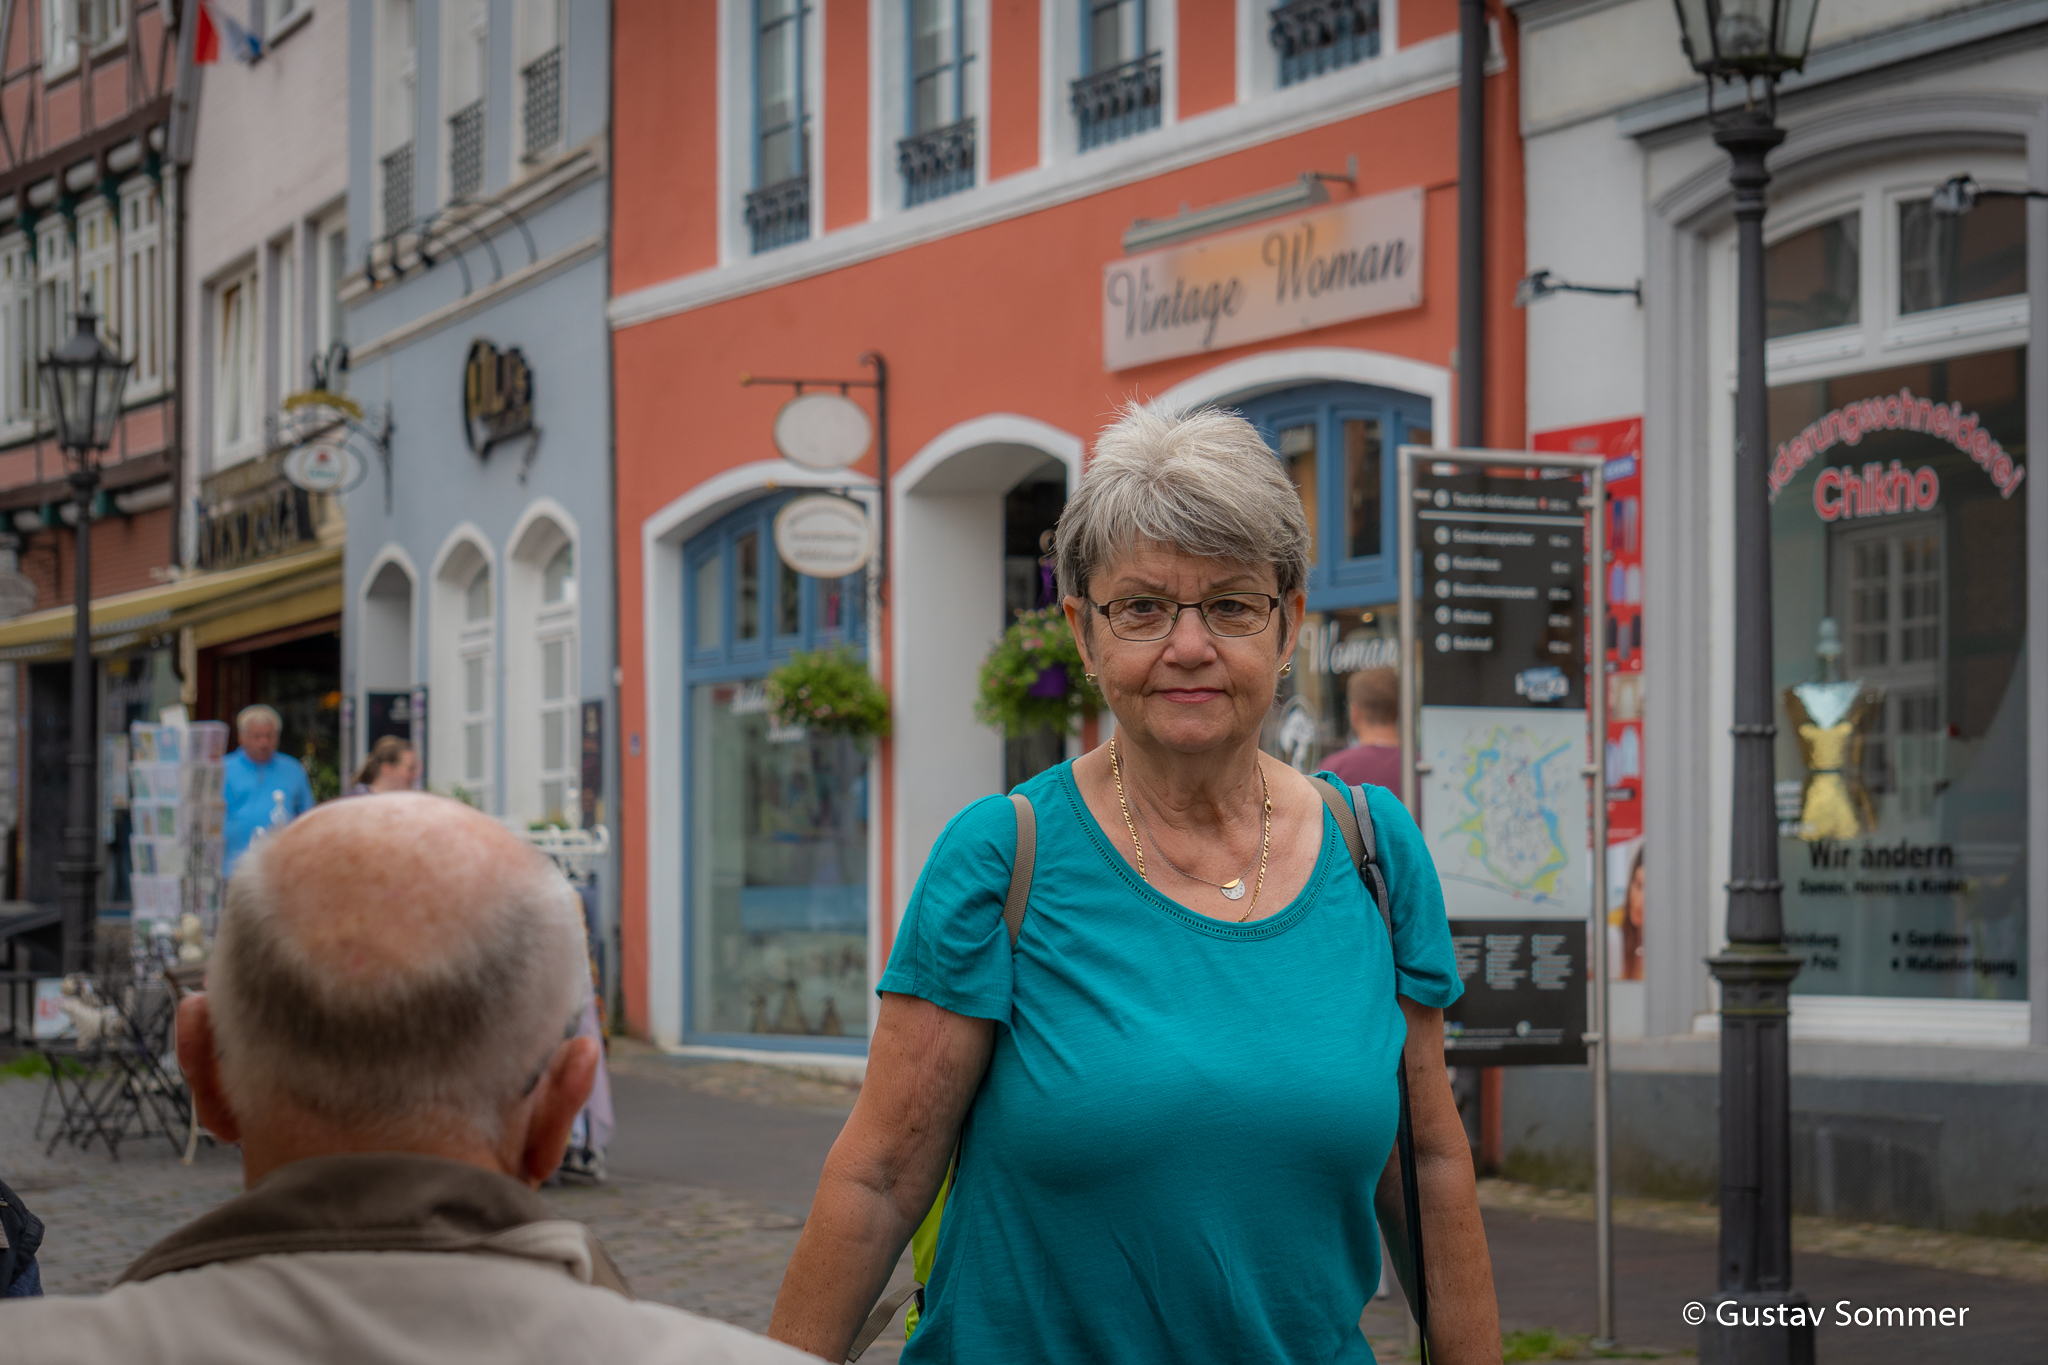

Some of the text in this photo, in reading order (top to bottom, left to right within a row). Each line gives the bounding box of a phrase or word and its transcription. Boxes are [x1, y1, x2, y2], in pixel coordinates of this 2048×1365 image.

[1107, 219, 1412, 347] Vintage Woman
[1813, 459, 1939, 521] Chikho
[1299, 620, 1398, 675] Woman
[1809, 837, 1953, 869] Wir ändern
